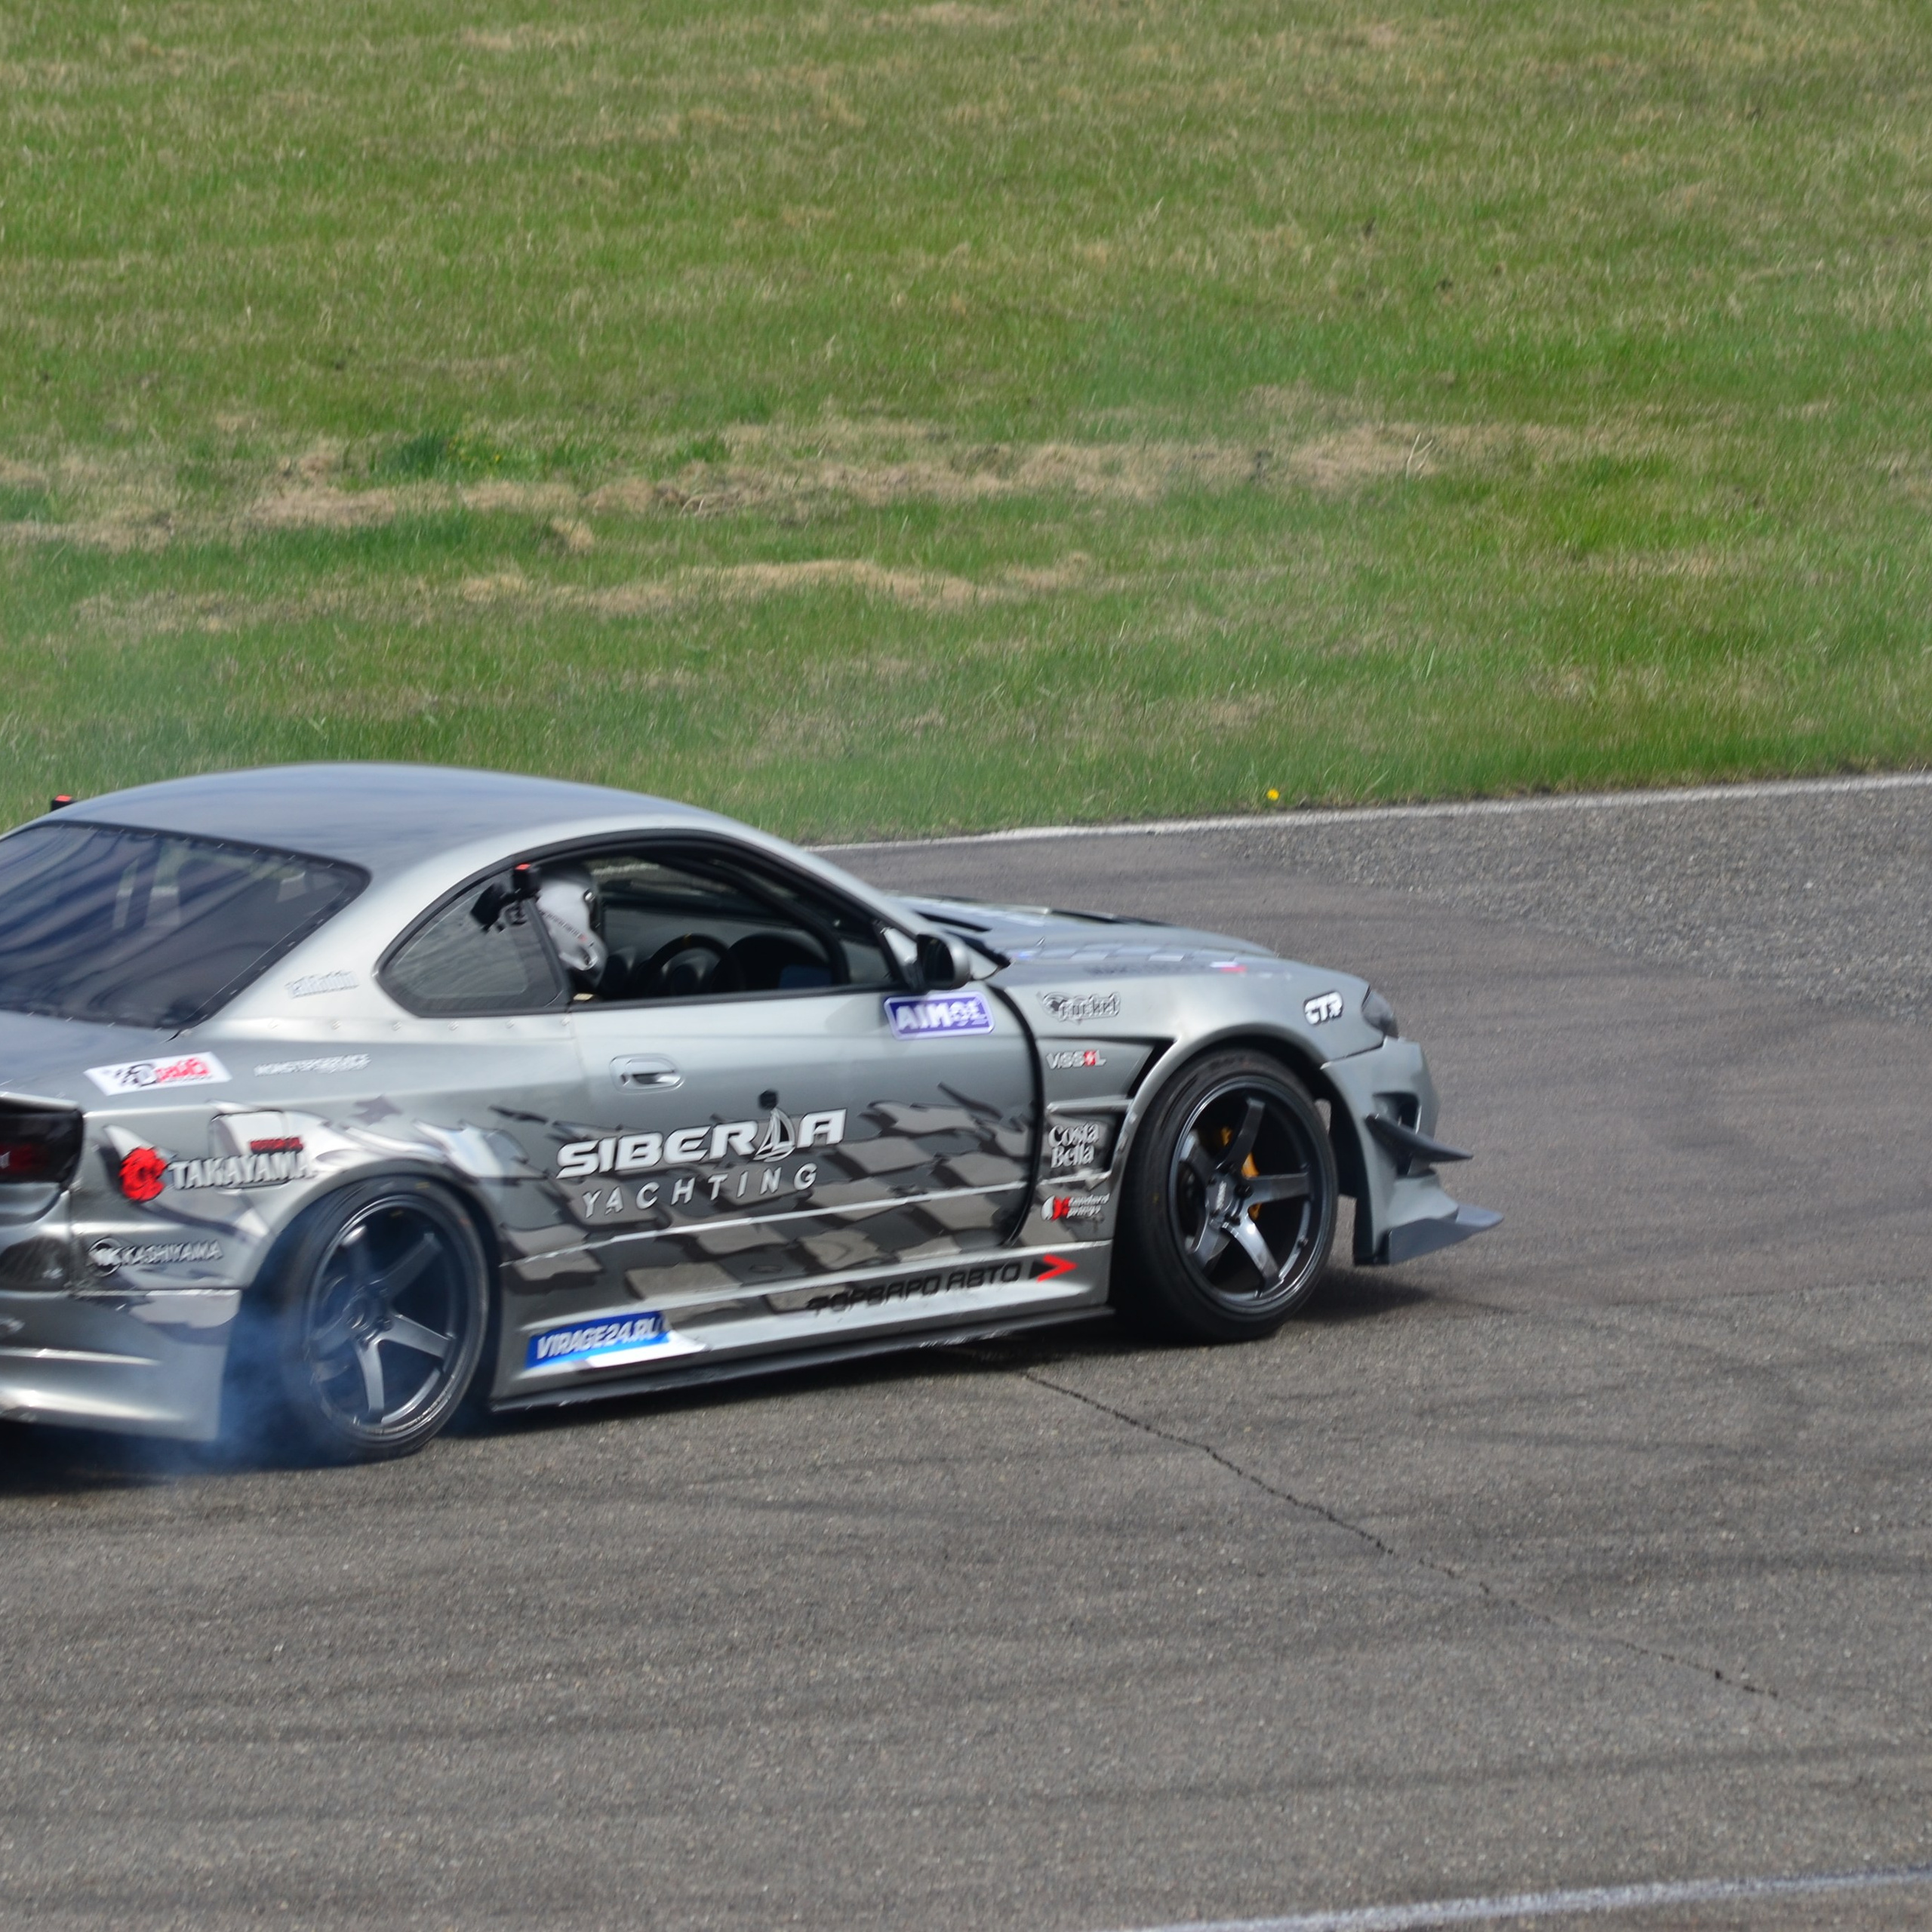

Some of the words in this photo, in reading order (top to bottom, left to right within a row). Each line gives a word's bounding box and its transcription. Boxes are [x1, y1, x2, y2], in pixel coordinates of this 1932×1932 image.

[1048, 1123, 1100, 1147] Costa
[168, 1152, 314, 1190] TAKAYAMA
[1051, 1143, 1095, 1168] Bella
[581, 1163, 818, 1219] YACHTING
[946, 1262, 1023, 1291] АВТО
[537, 1317, 662, 1359] VIRAGE24.RU
